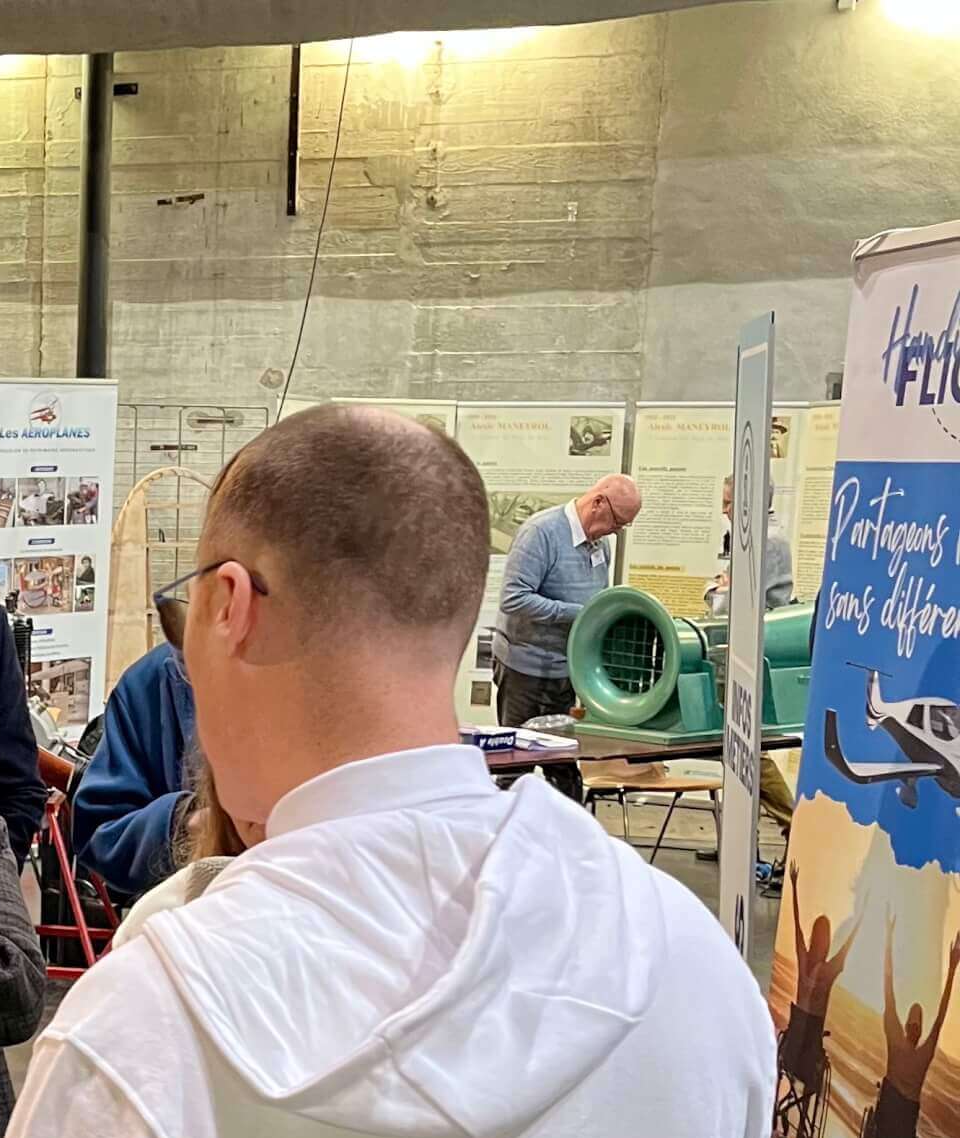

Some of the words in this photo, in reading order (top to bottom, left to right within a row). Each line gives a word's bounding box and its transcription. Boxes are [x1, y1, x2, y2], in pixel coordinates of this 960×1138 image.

[0, 427, 18, 438] Les
[832, 477, 949, 578] Partageons
[825, 582, 876, 636] sans
